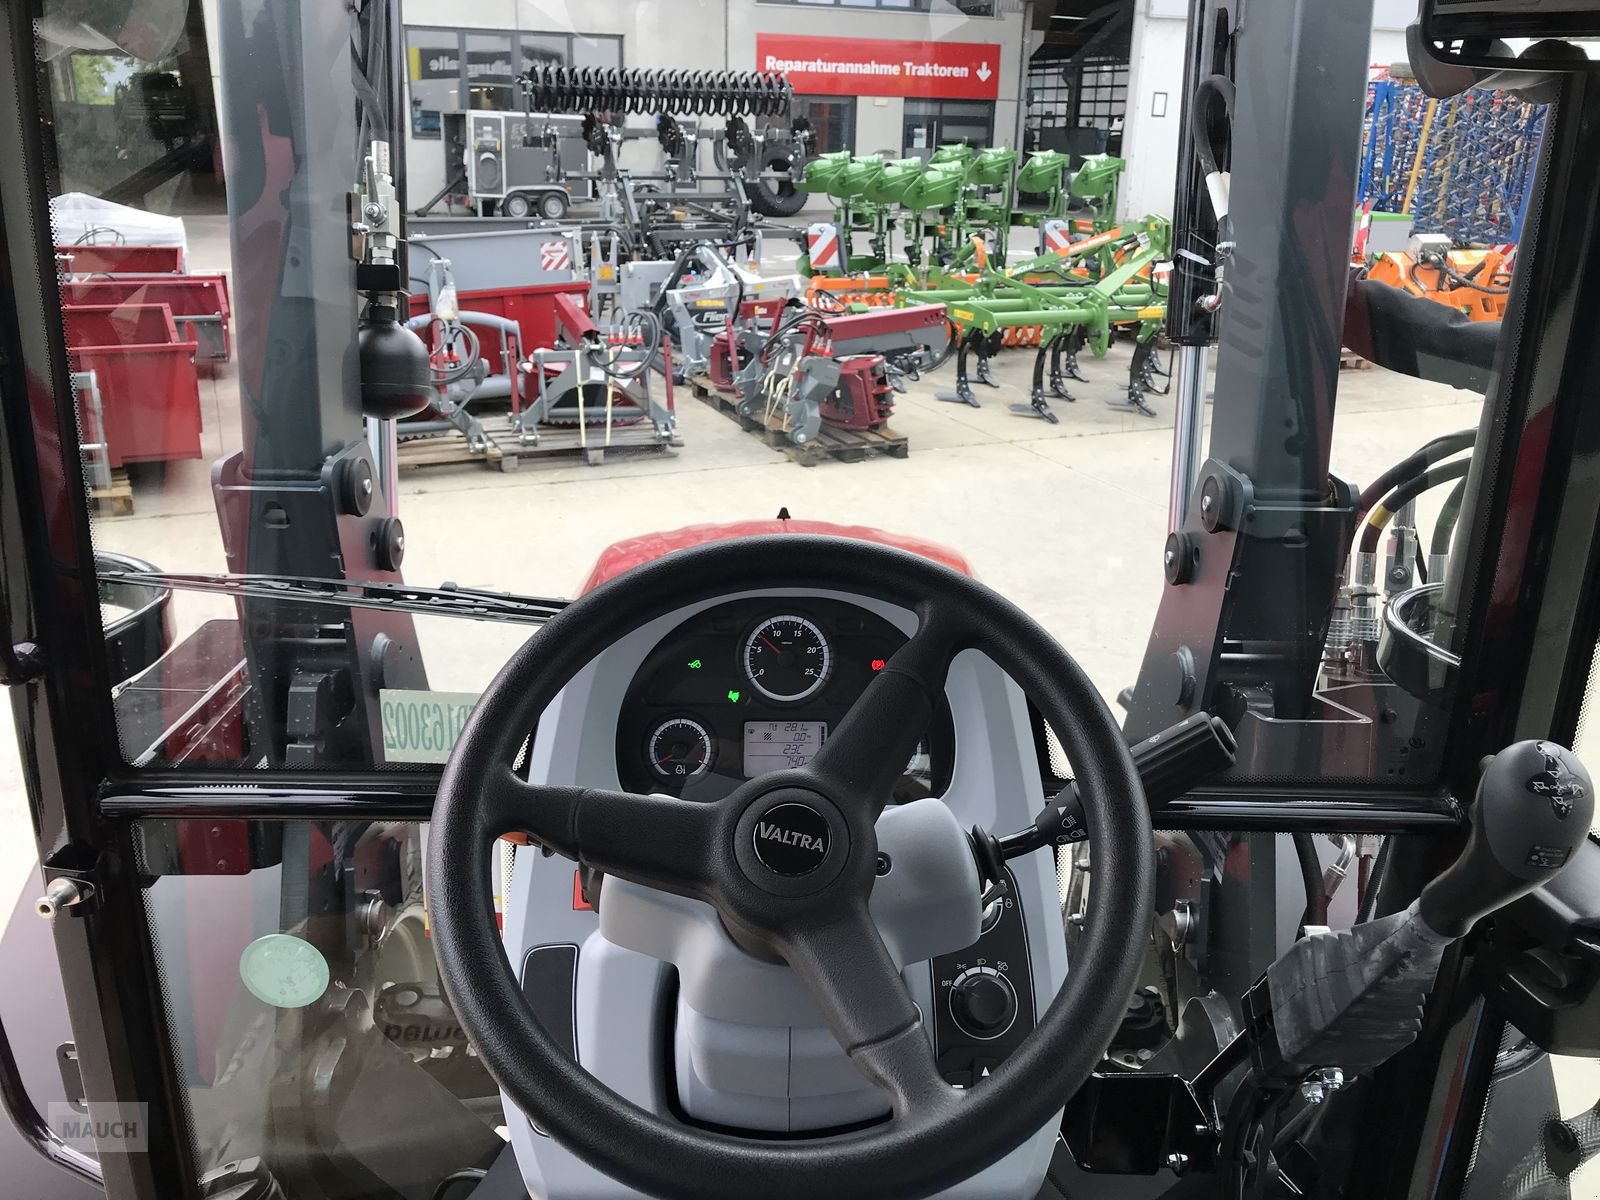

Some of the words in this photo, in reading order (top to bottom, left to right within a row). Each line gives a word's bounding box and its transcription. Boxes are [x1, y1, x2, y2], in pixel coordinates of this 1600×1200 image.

[765, 55, 900, 76] Reparaturannahme
[903, 61, 969, 78] Traktoren
[806, 646, 817, 654] 20
[759, 821, 825, 853] VALTRA
[941, 979, 953, 987] OFF
